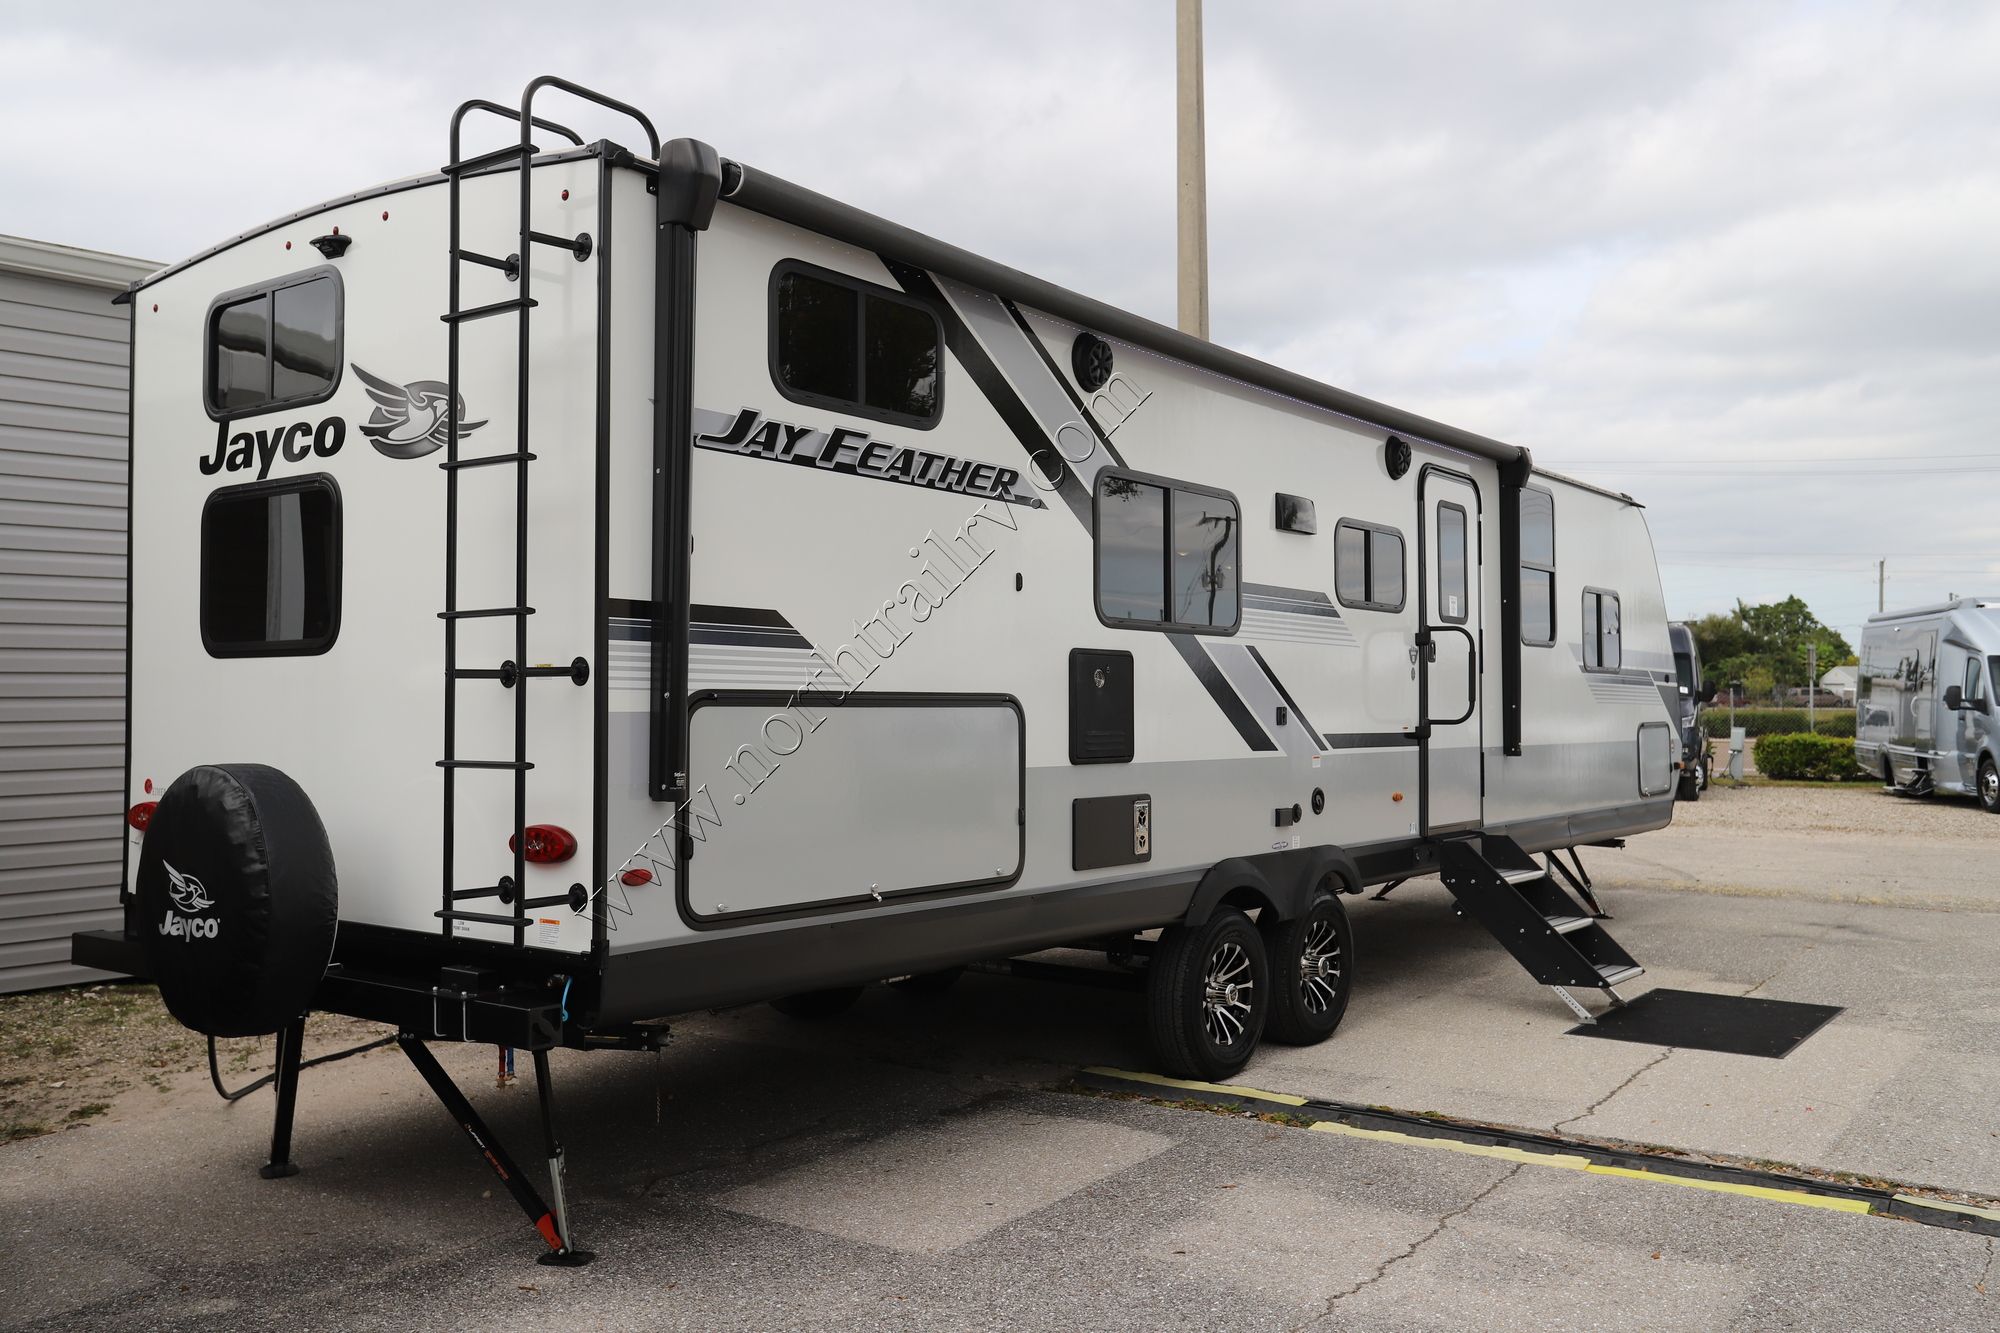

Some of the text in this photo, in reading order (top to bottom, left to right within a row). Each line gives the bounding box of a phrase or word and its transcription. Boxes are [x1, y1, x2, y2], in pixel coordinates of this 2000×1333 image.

[199, 416, 346, 481] Jayco
[697, 407, 1020, 501] JAY FEATHER
[159, 910, 220, 942] Jayco
